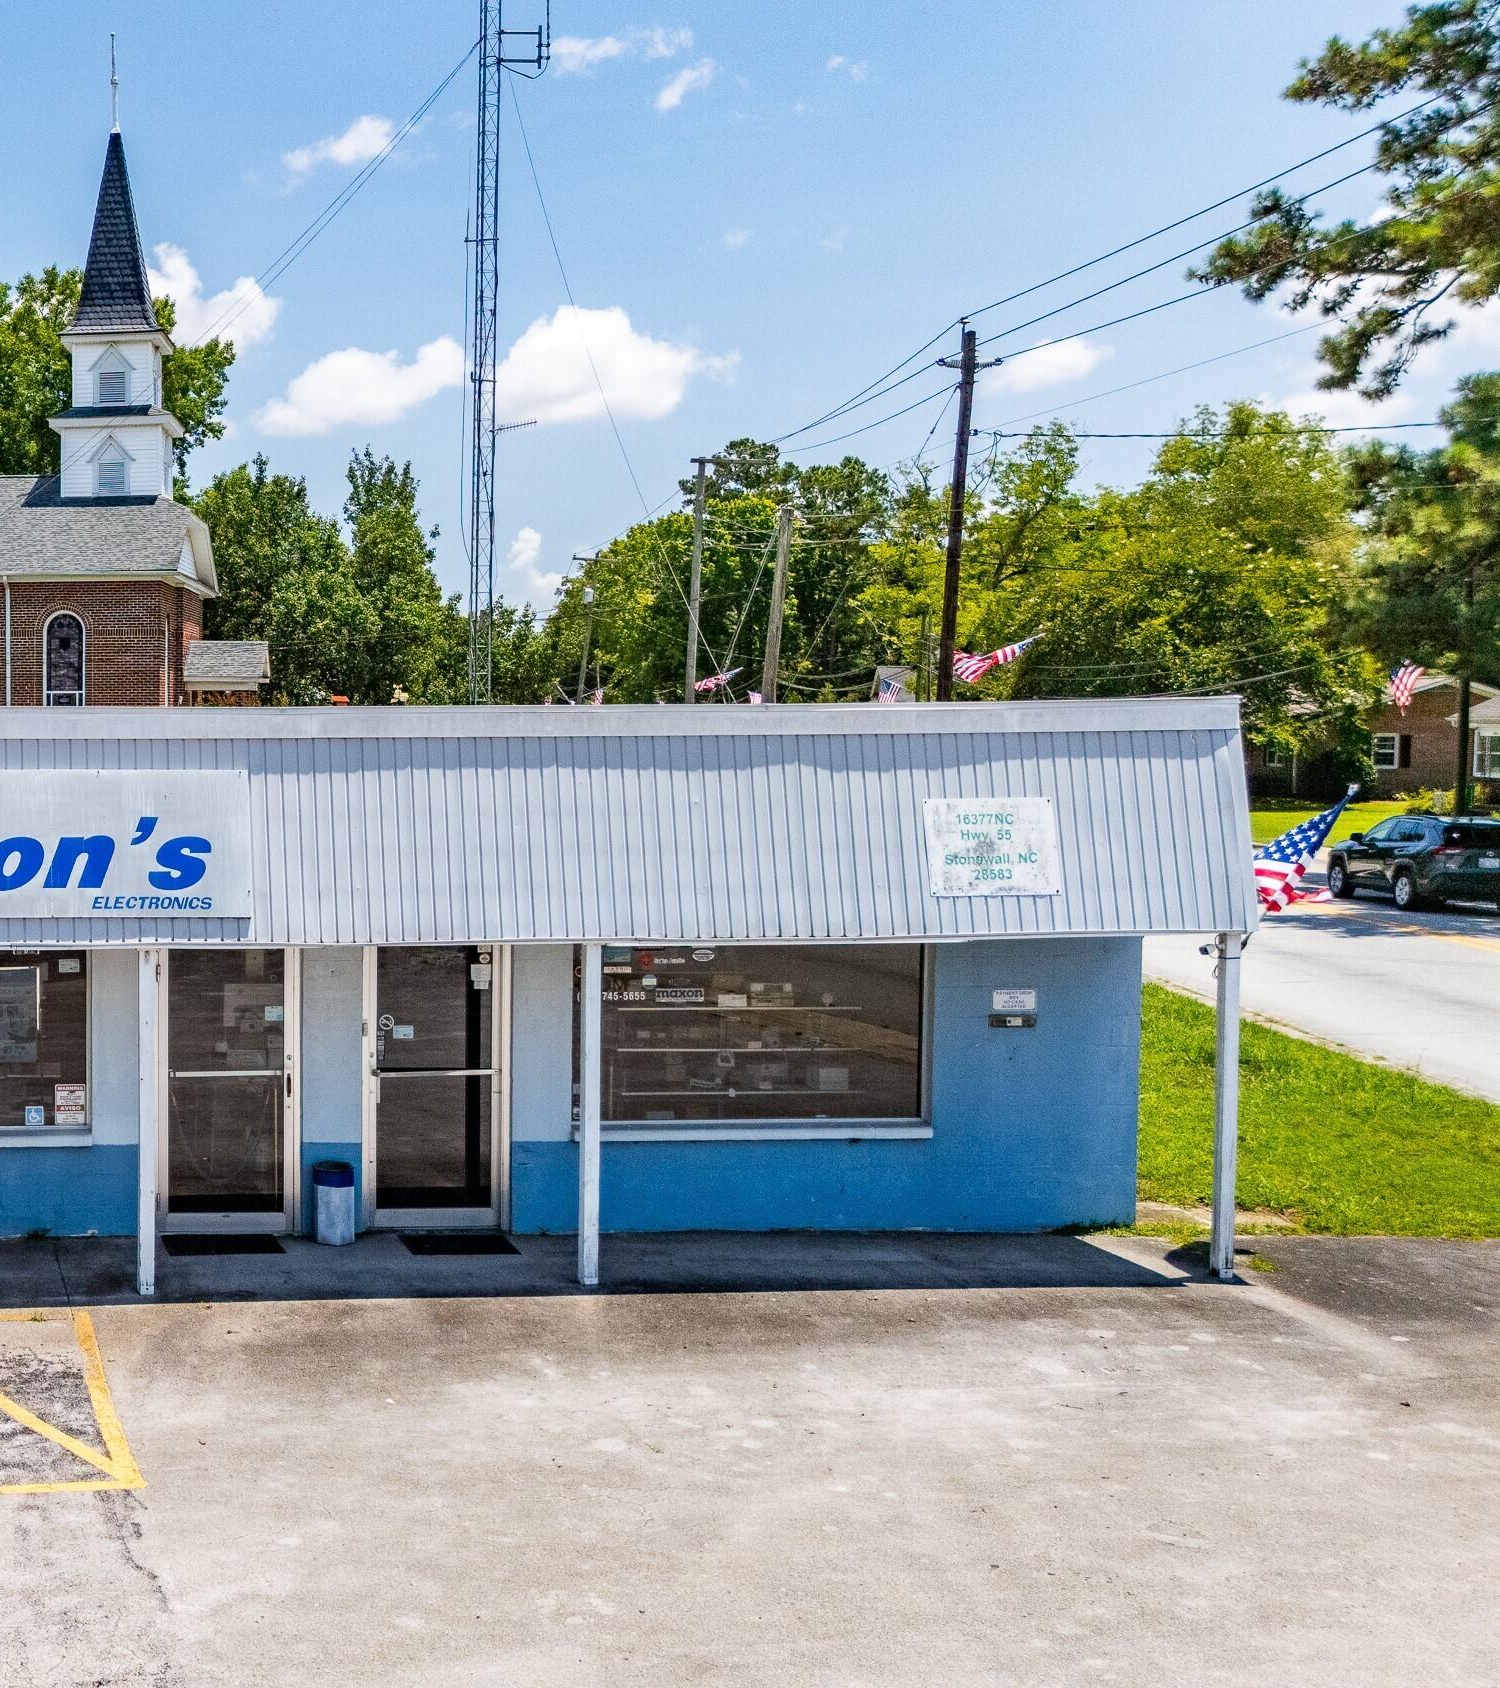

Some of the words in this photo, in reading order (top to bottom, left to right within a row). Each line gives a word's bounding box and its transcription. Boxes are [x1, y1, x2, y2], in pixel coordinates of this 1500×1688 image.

[997, 829, 1012, 840] 55
[1018, 852, 1038, 864] NC
[91, 895, 212, 910] ELECTRONICS
[601, 991, 646, 1001] 745-5655
[655, 989, 704, 999] maxon
